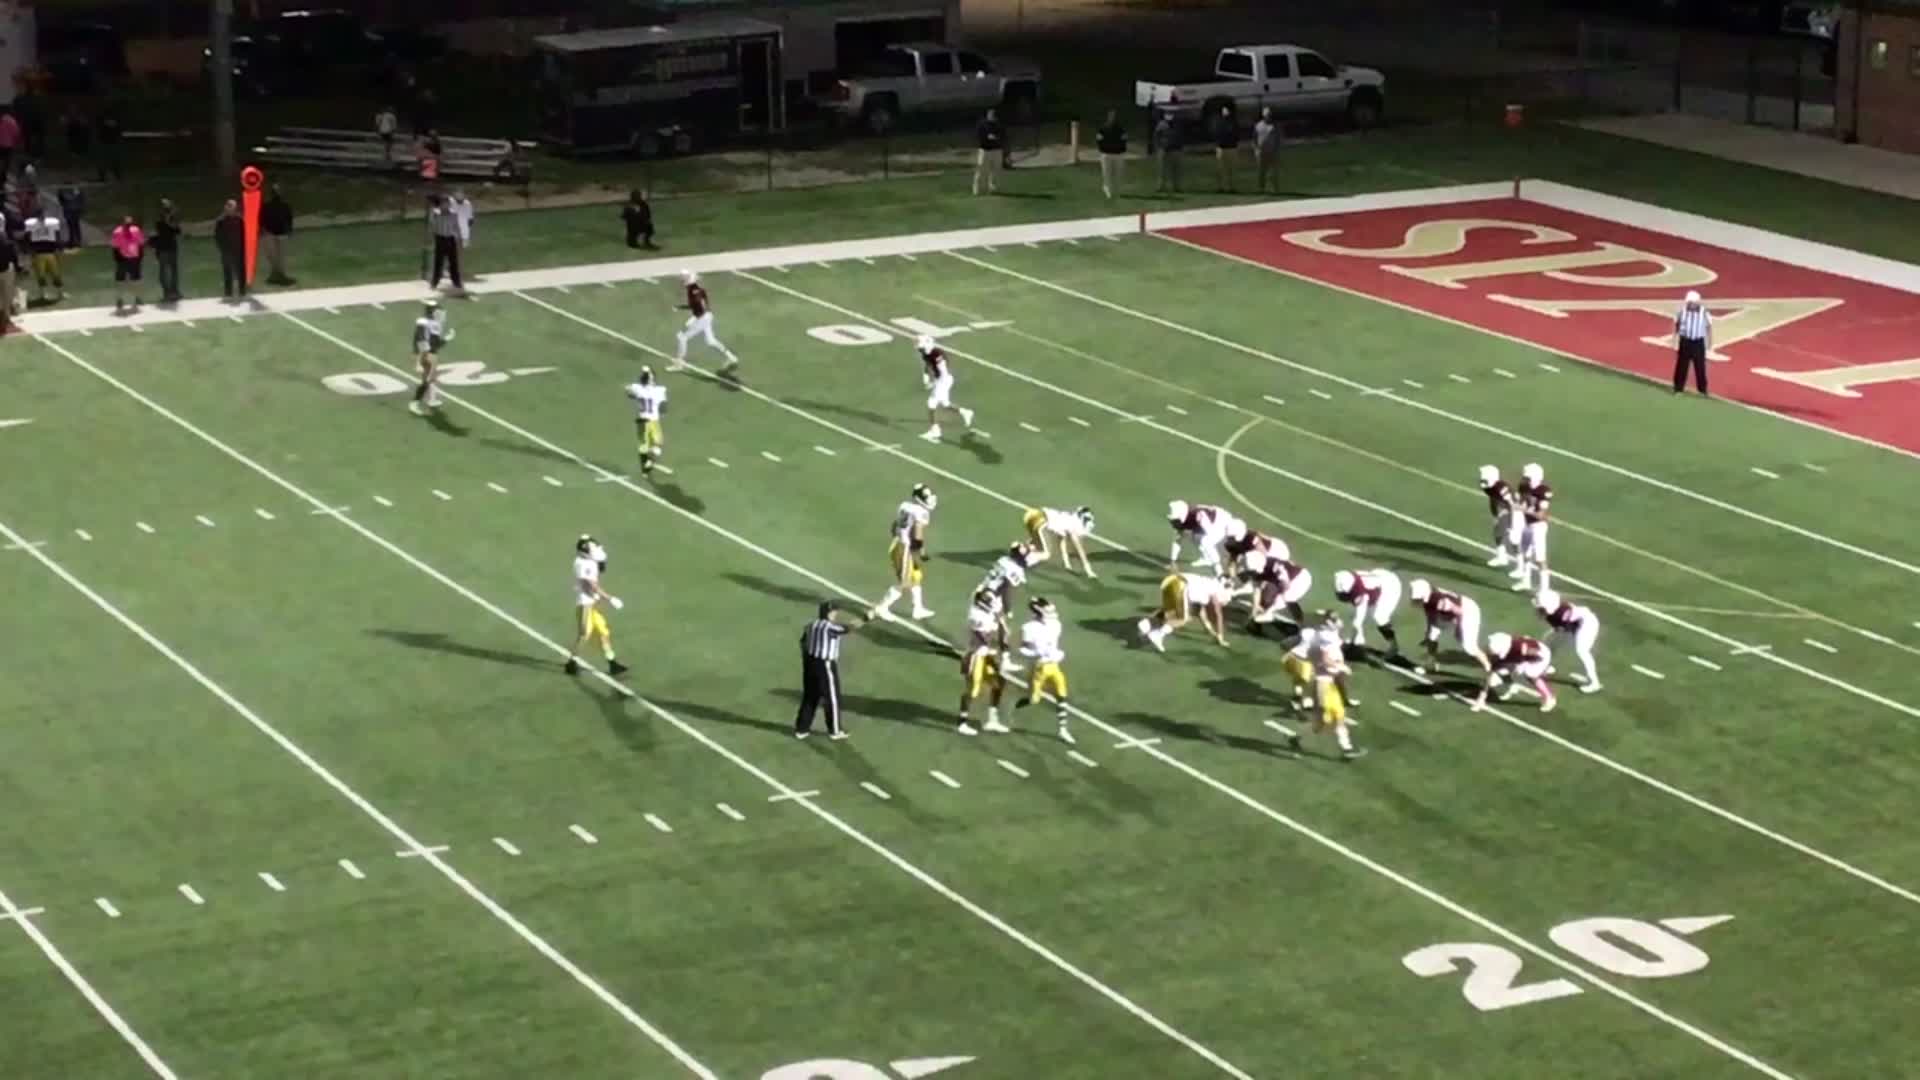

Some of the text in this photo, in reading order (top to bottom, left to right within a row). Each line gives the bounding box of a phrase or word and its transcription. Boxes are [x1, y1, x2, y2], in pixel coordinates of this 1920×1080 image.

[806, 316, 972, 346] 10
[320, 360, 511, 396] 20
[1402, 916, 1711, 1012] 20
